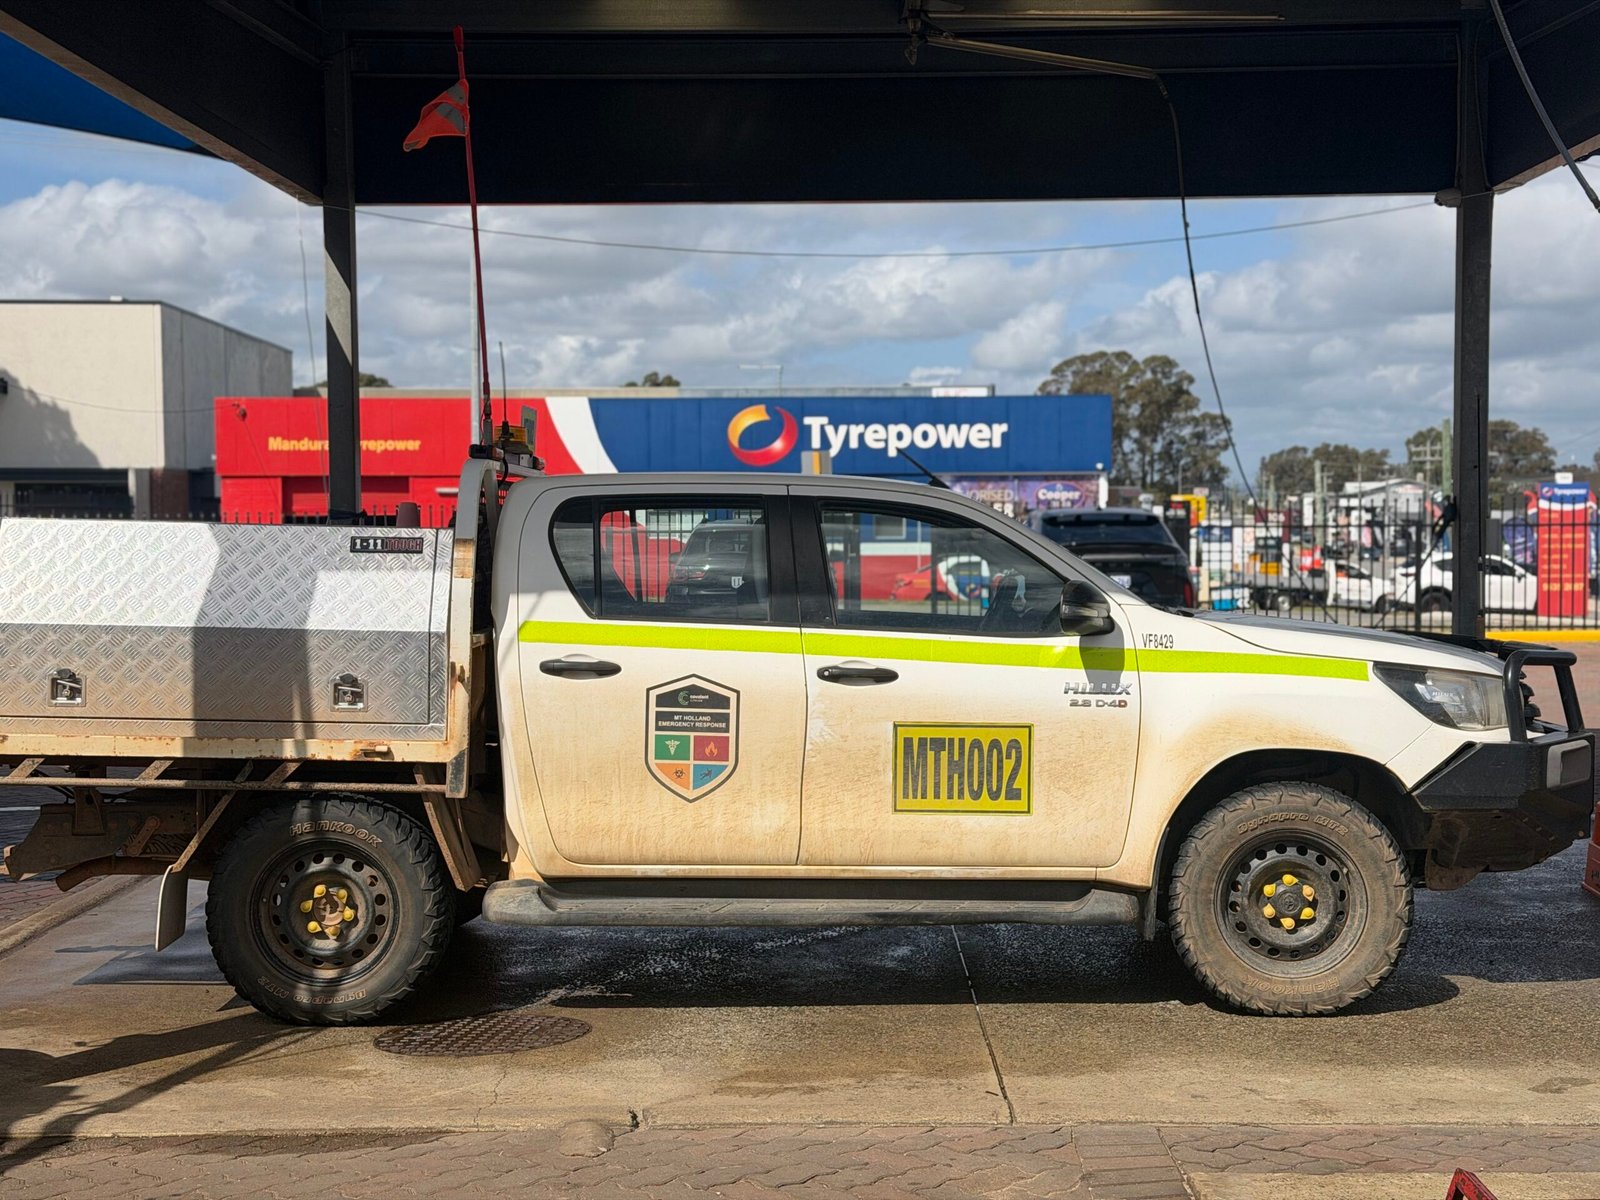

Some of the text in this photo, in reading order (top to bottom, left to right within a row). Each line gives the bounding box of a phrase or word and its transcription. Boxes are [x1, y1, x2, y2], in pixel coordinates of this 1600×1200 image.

[803, 415, 1009, 457] Tyrepower
[268, 436, 421, 453] Mandura repower
[1037, 489, 1081, 502] Cooper
[385, 538, 422, 551] TOUGH
[1141, 633, 1174, 649] VF8429
[1063, 682, 1133, 696] HILUX
[1095, 699, 1128, 709] D-4D
[902, 736, 1023, 801] MTH002
